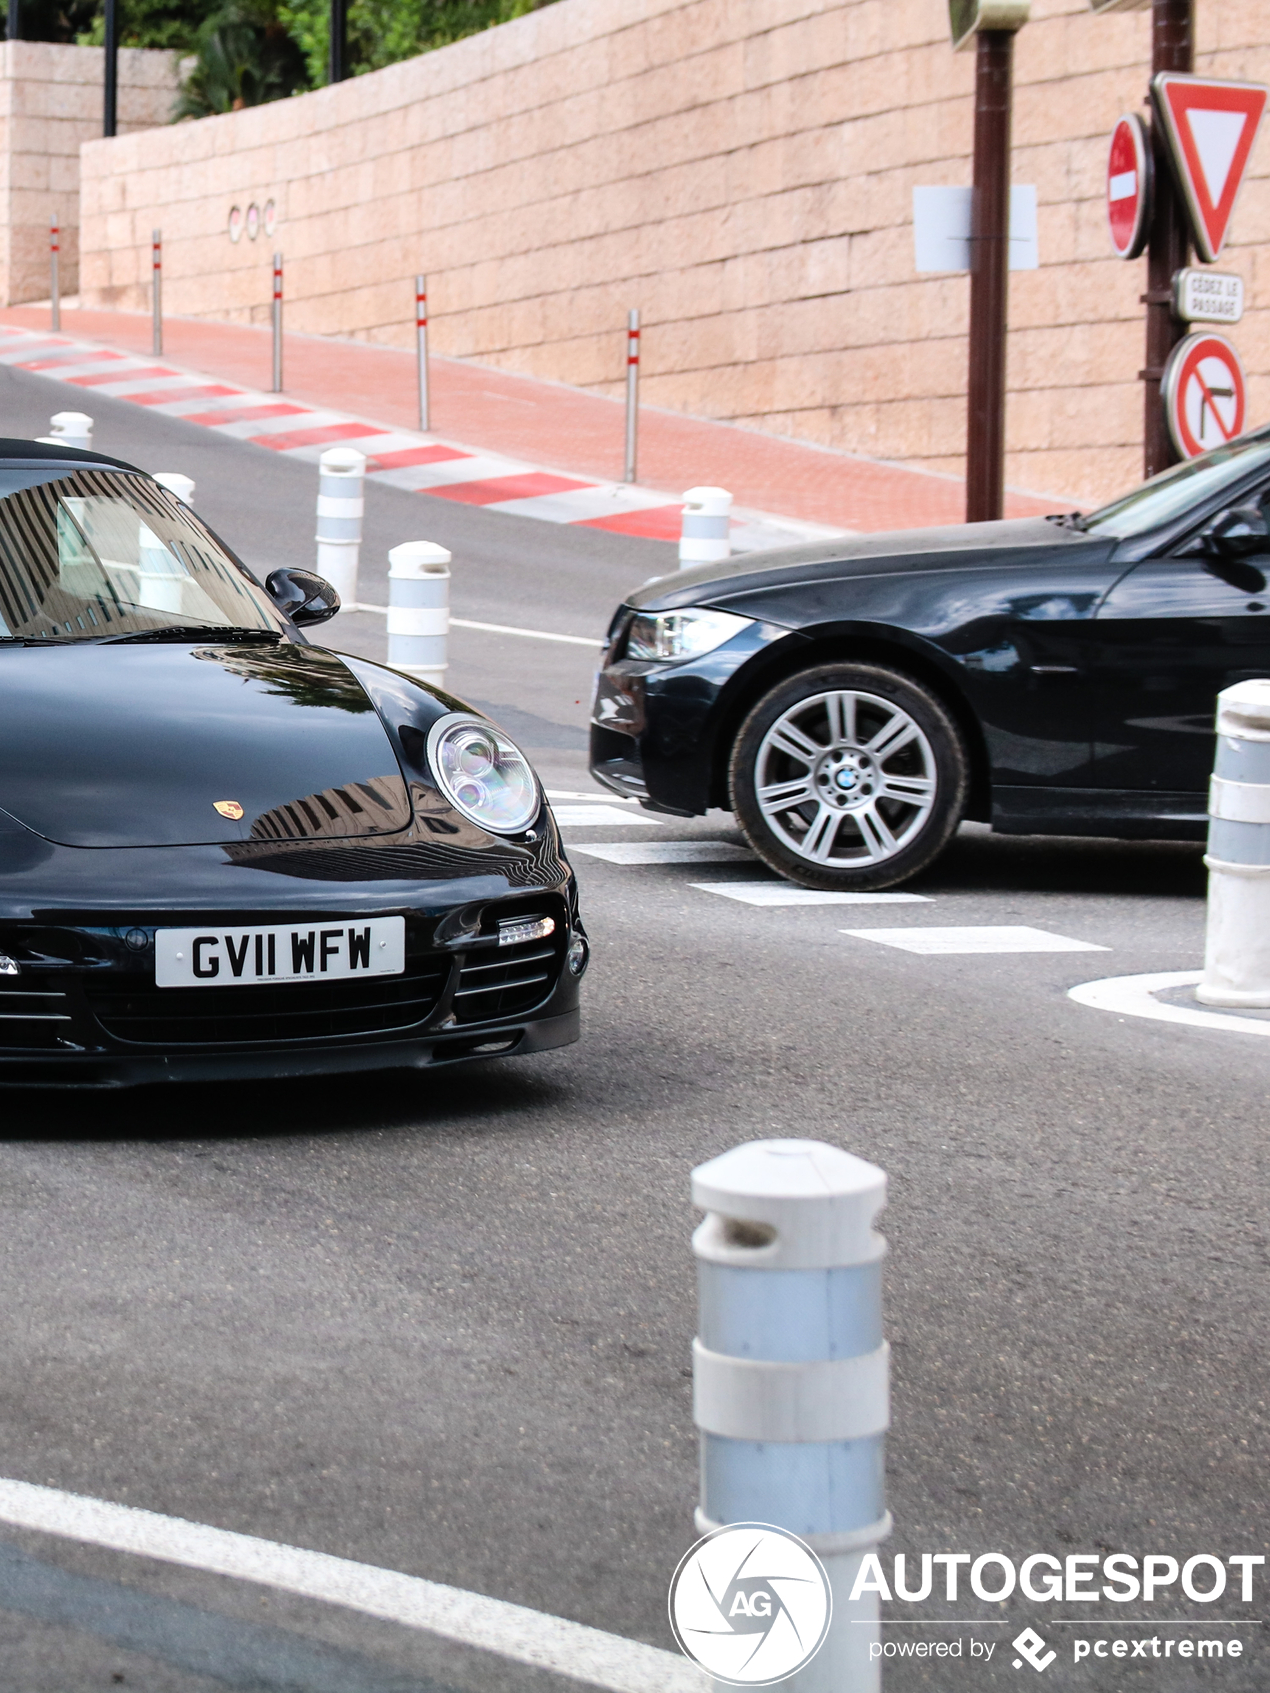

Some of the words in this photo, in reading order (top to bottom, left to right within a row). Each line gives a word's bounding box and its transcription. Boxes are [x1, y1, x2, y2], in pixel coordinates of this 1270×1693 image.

[1191, 275, 1223, 295] CÉDEZ
[1227, 281, 1238, 297] LE
[1191, 297, 1237, 317] PASSAGE
[192, 933, 276, 978] GV11
[290, 926, 371, 974] WFW
